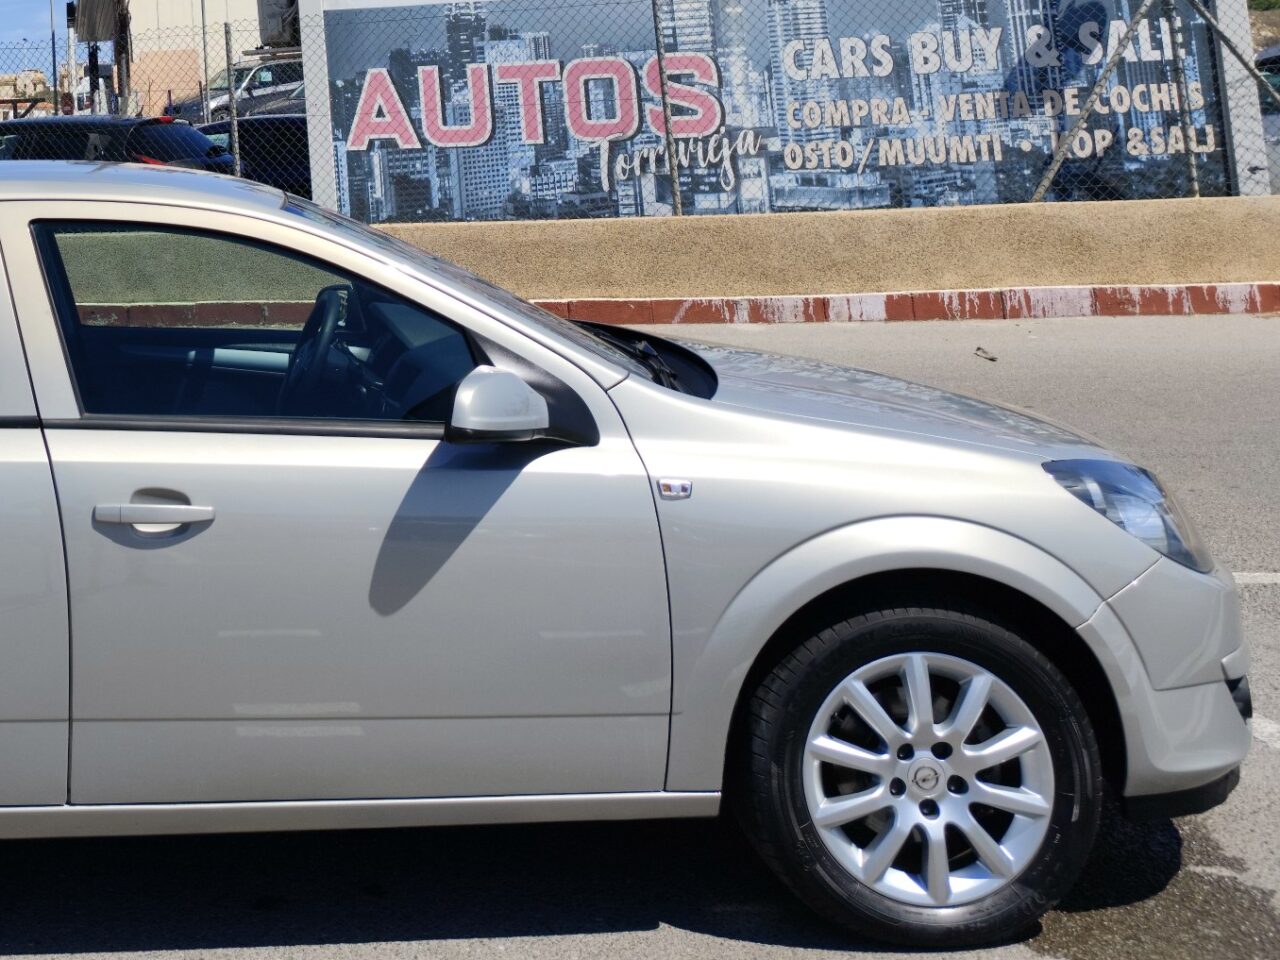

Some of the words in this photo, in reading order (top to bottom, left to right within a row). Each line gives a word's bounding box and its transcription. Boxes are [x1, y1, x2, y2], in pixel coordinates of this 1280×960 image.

[782, 33, 895, 81] CARS
[909, 26, 1003, 75] BUY
[1024, 24, 1062, 68] &
[1078, 16, 1186, 66] SALE
[346, 52, 725, 152] AUTOS
[786, 96, 912, 130] COMPRA
[938, 90, 1033, 123] VENTA
[1042, 87, 1081, 117] DE
